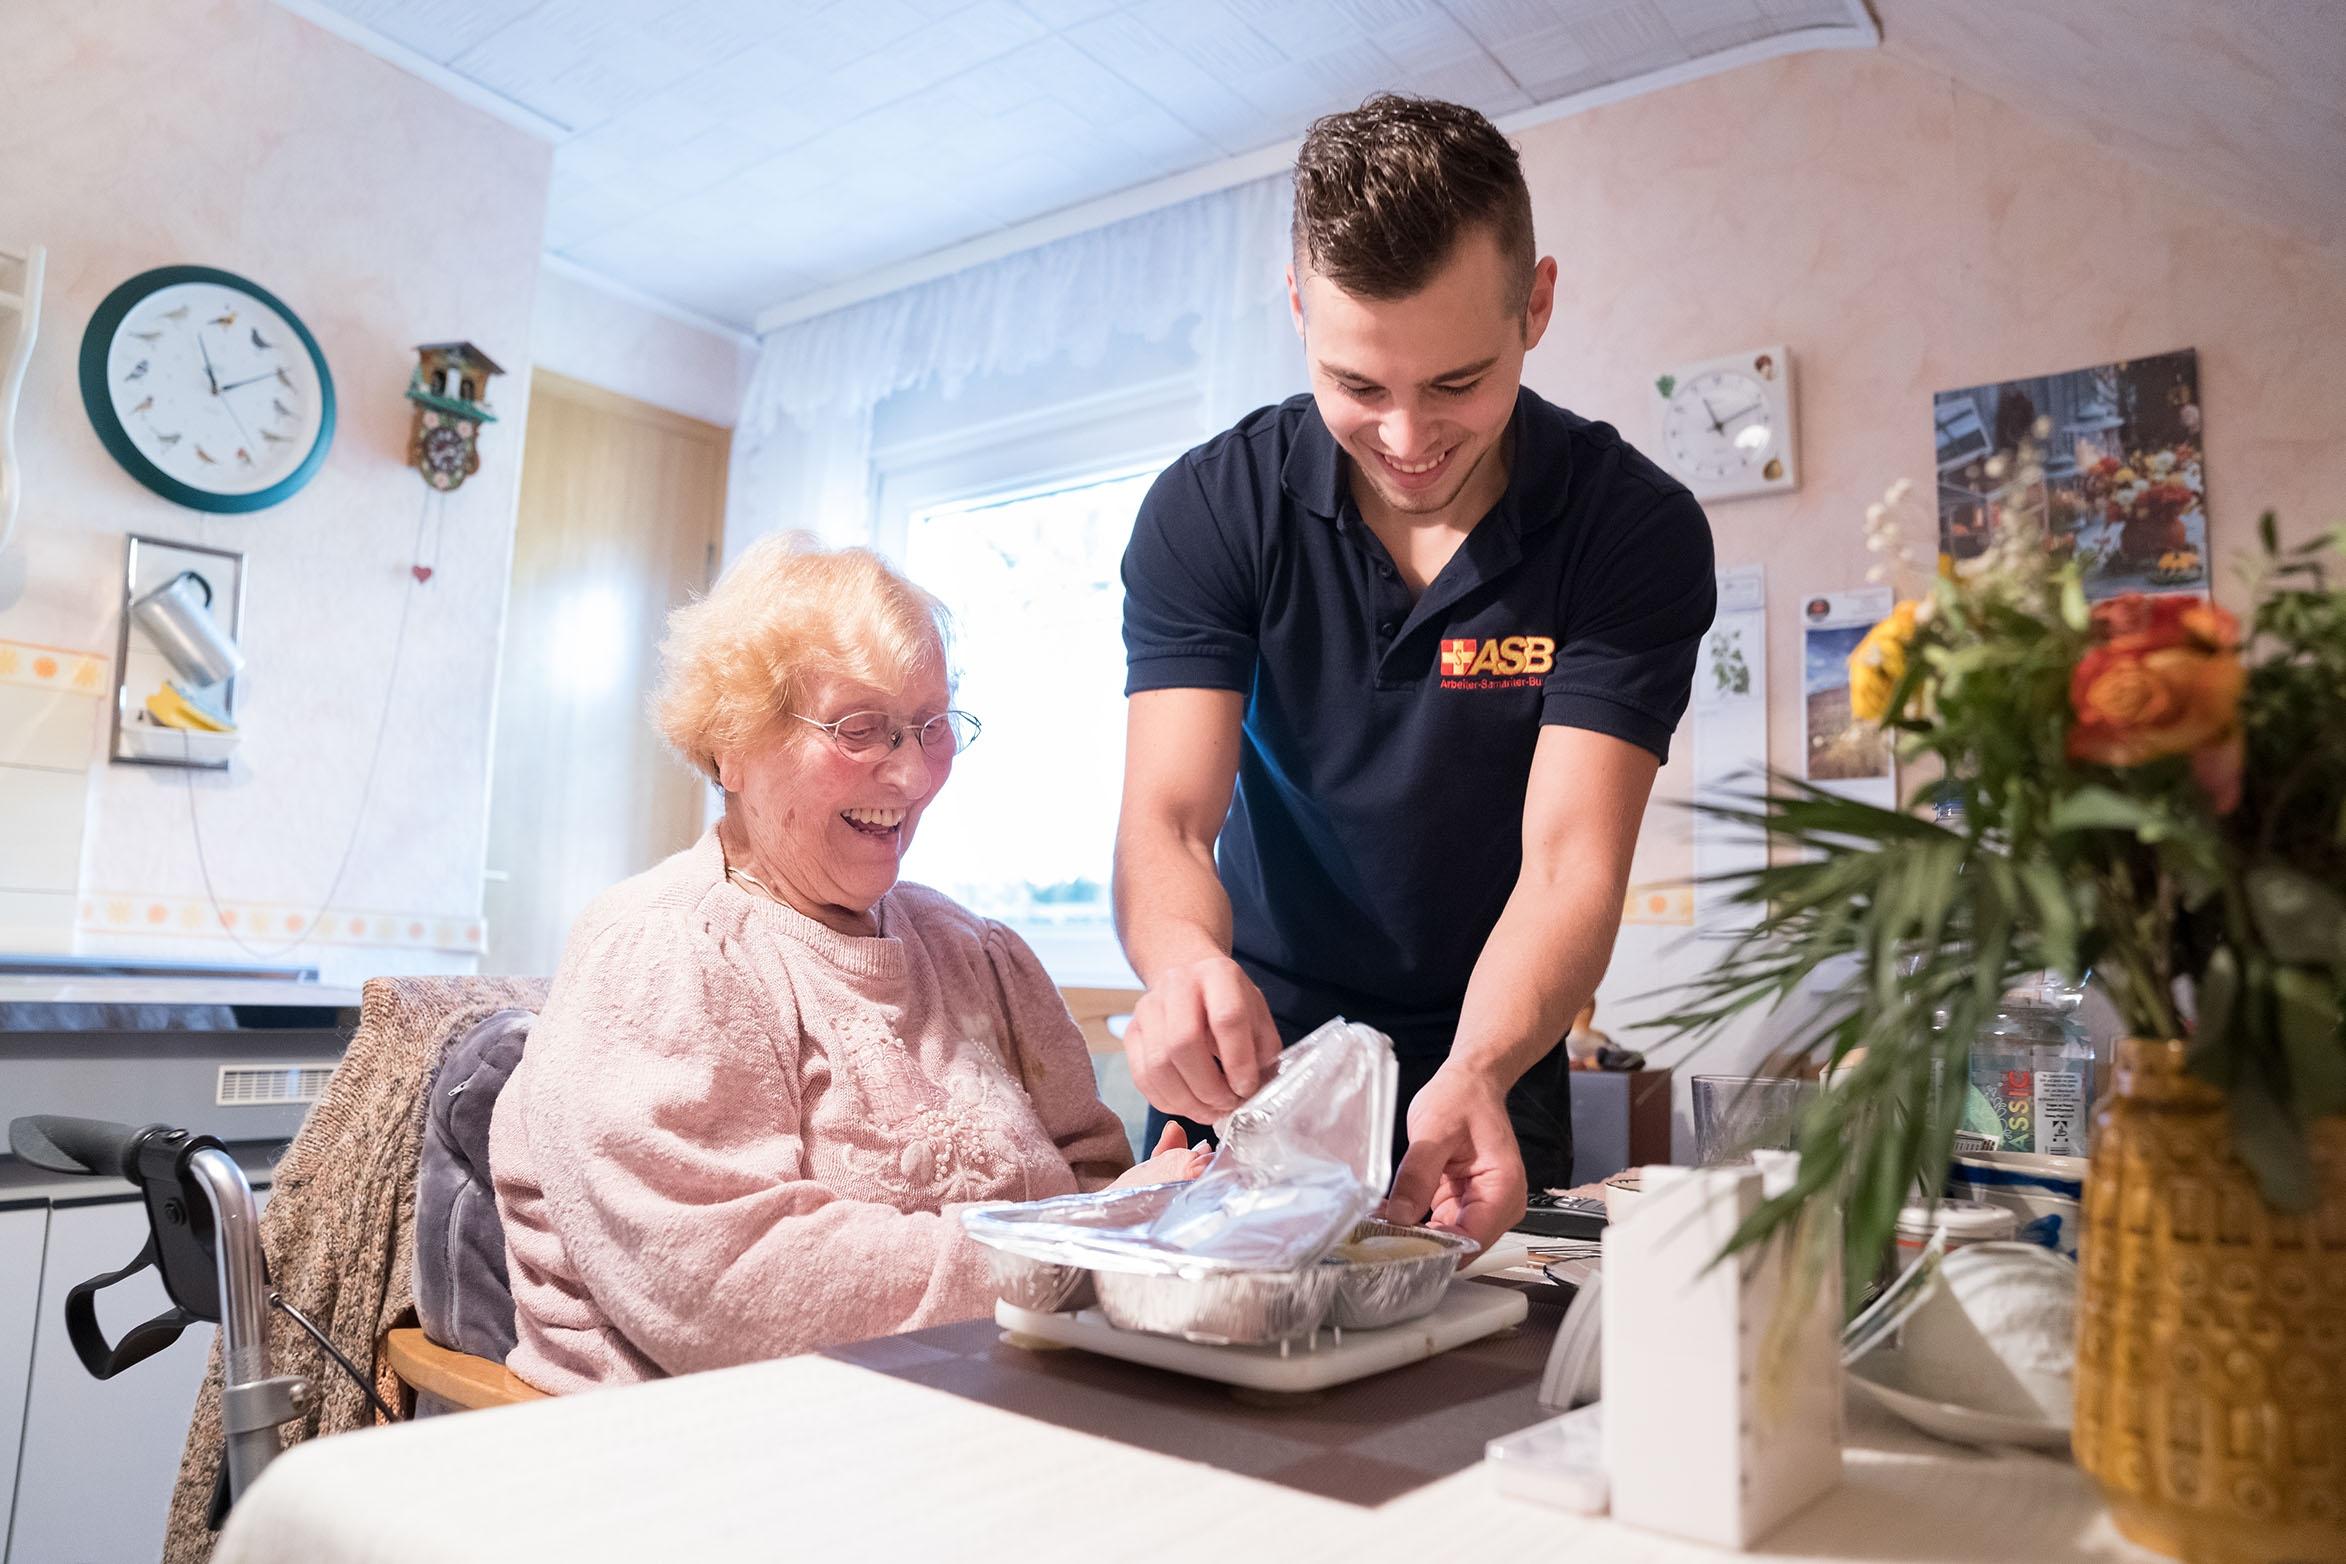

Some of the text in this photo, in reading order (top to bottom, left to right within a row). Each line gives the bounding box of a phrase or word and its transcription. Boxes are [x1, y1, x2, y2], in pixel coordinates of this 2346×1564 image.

[1466, 635, 1555, 676] ASB
[1440, 677, 1543, 690] Arbeiter-Samariter-Bu
[2008, 1071, 2031, 1152] ASSIC
